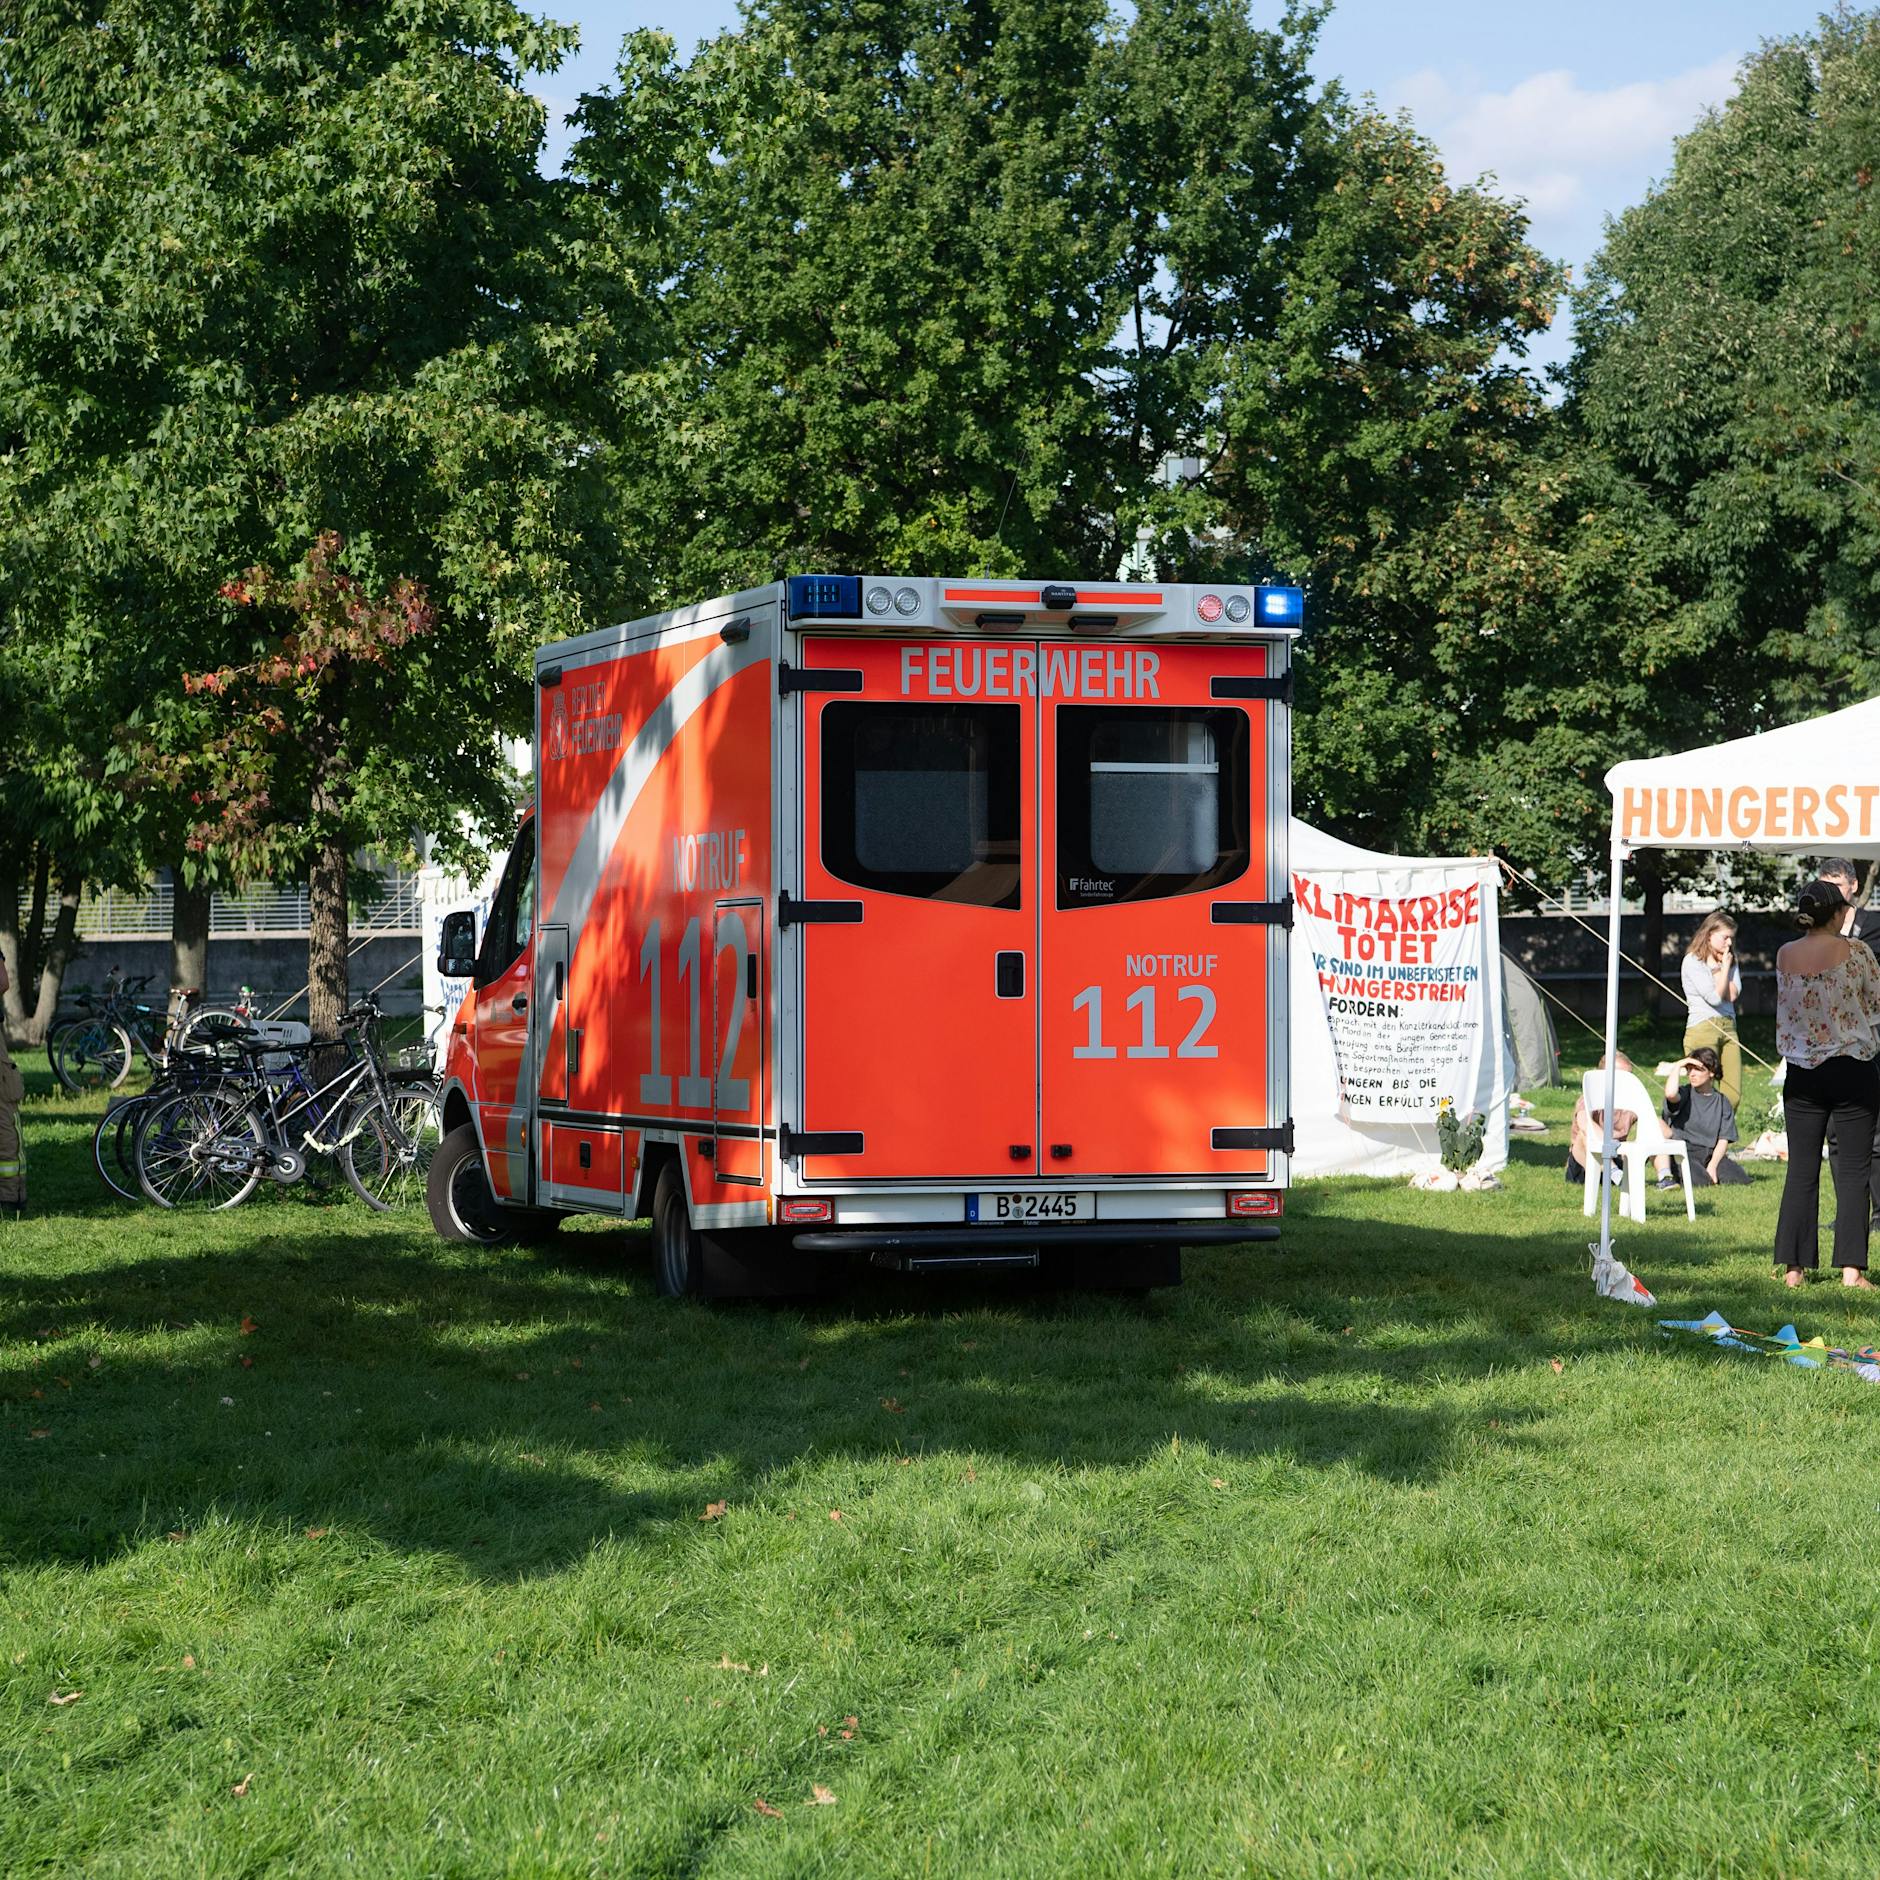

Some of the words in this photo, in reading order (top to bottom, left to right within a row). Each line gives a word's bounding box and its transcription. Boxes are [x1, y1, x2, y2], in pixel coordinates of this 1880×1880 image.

[901, 646, 1161, 699] FEUERWEHR
[571, 681, 606, 717] BERLINER
[571, 712, 623, 756] FEUERWEHR
[1622, 784, 1880, 838] HUNGERST
[673, 829, 746, 893] NOTRUF
[1291, 871, 1480, 932] KLIMAKRISE
[1337, 925, 1437, 965] TÖTET
[1126, 954, 1218, 977] NOTRUF
[1330, 957, 1363, 977] SIND
[1366, 964, 1384, 980] IM
[1318, 971, 1467, 1003] HUNGERSTREIK
[639, 911, 750, 1112] 112
[1072, 984, 1219, 1059] 112
[1329, 996, 1404, 1018] FORDERN:
[1379, 1094, 1424, 1108] ERFÜLLT
[1392, 1079, 1410, 1090] BIS
[1419, 1077, 1437, 1089] DIE
[996, 1196, 1010, 1218] B
[1025, 1195, 1076, 1217] 2445
